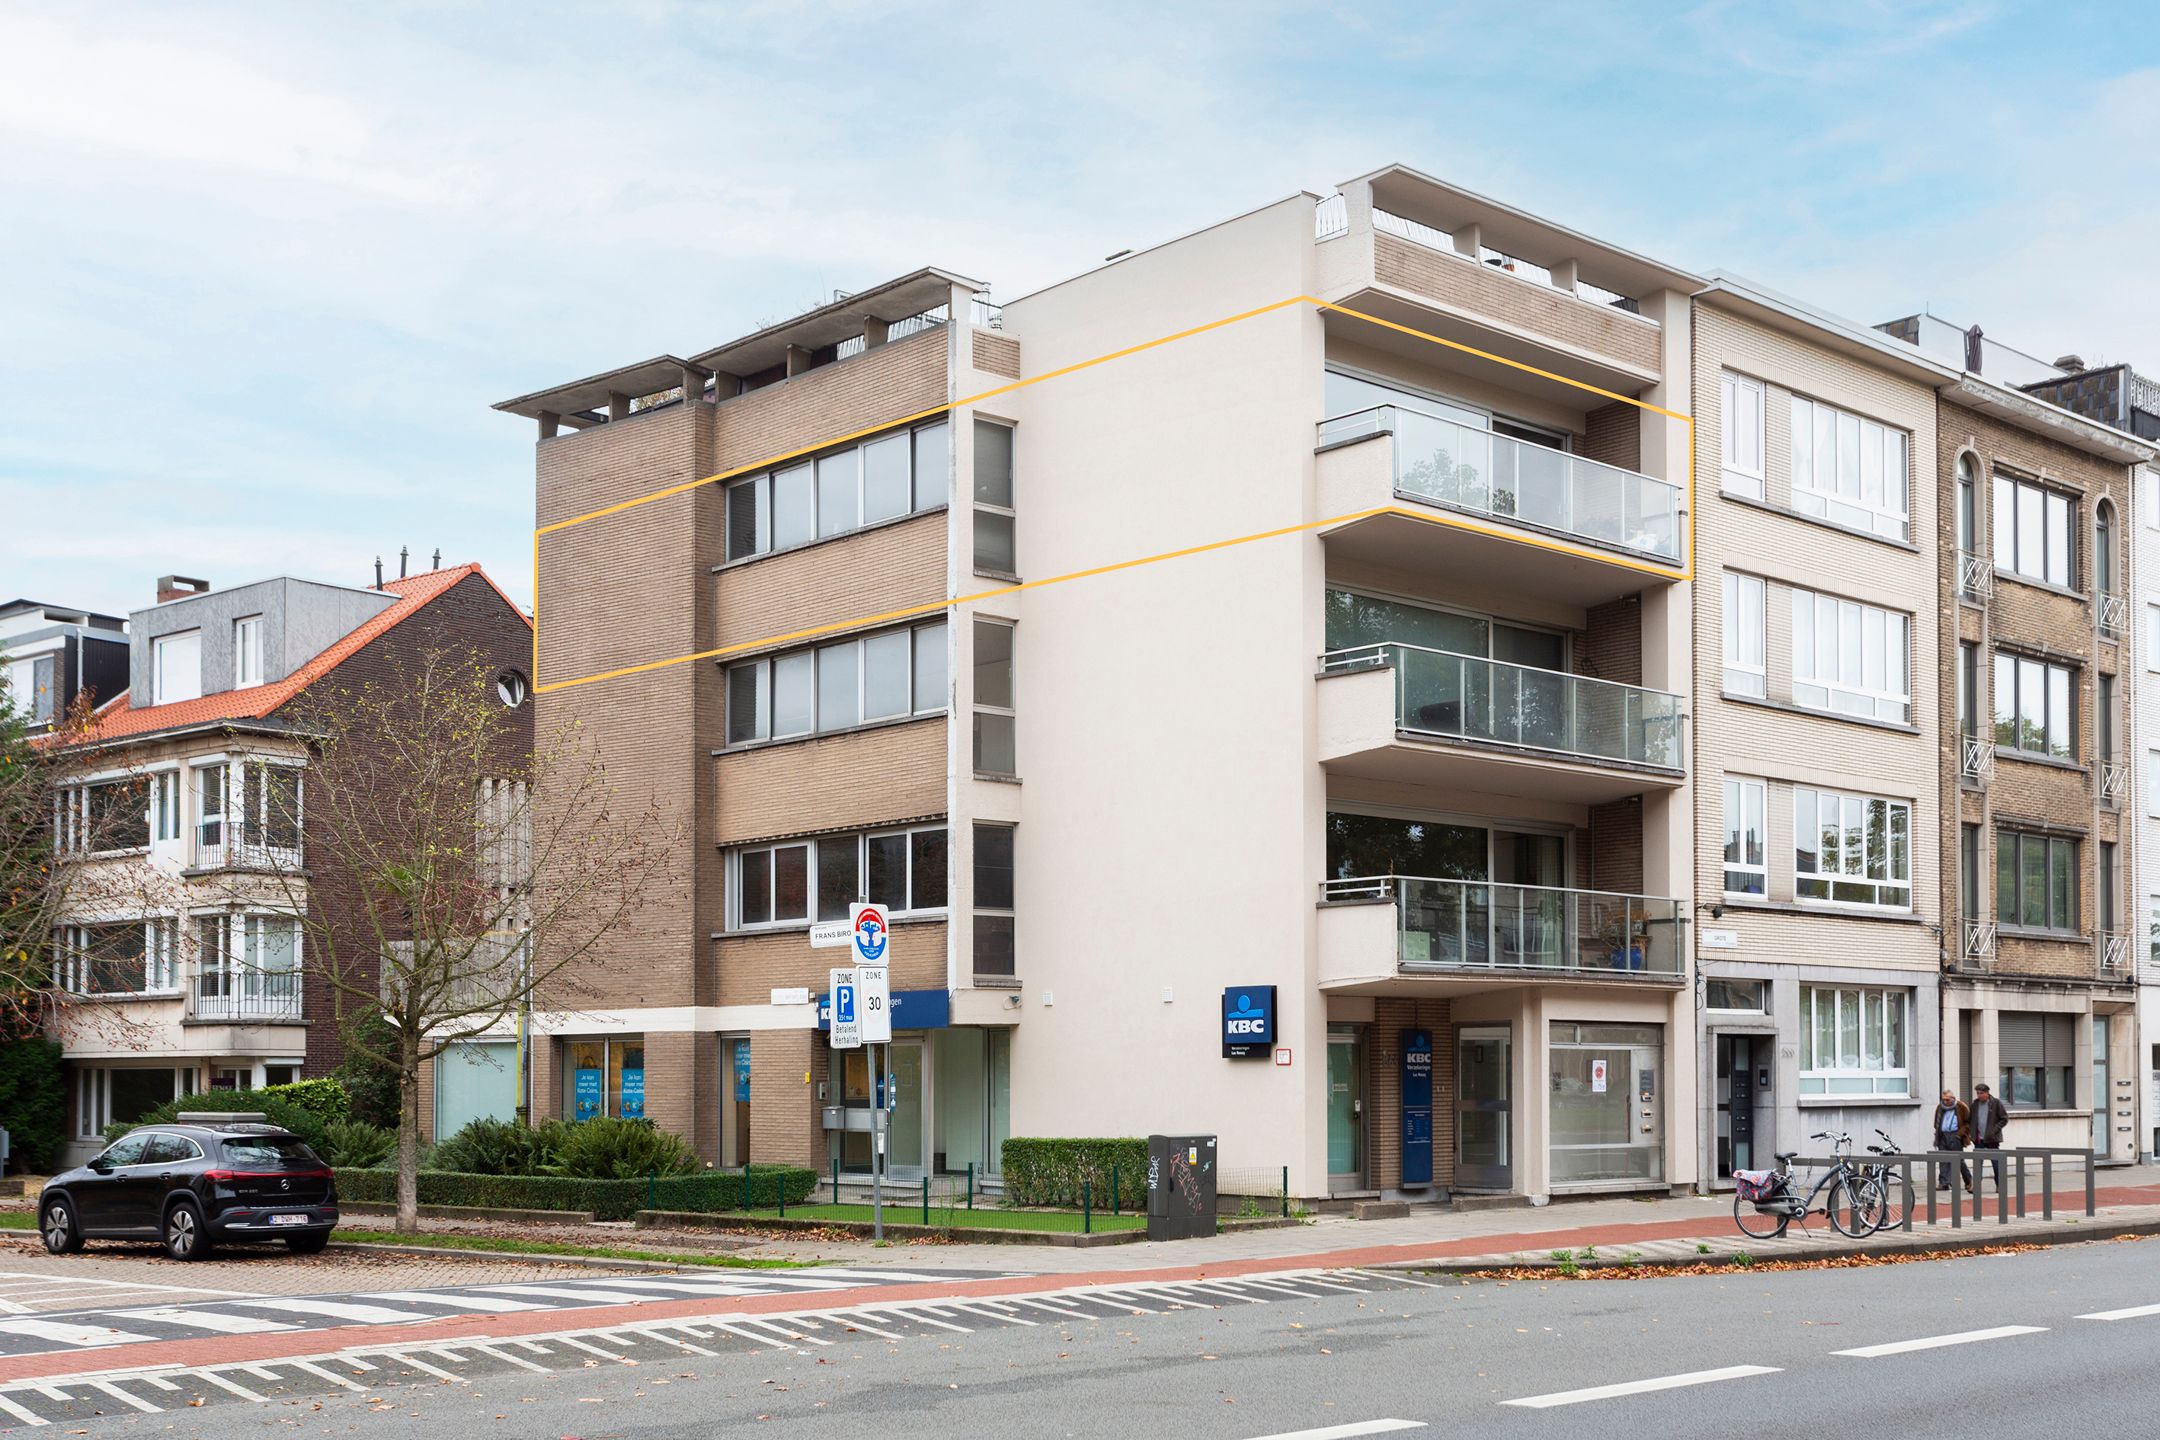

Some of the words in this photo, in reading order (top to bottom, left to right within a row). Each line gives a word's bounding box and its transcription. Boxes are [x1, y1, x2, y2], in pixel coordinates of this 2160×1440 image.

[815, 931, 836, 939] FRANS
[837, 974, 853, 984] ZONE
[866, 971, 882, 979] ZONE
[841, 989, 850, 1013] P
[868, 996, 881, 1011] 30
[836, 1024, 857, 1034] Betalend
[1228, 1020, 1264, 1033] KBC
[835, 1036, 858, 1045] Herhaling
[1407, 1053, 1431, 1063] KBC
